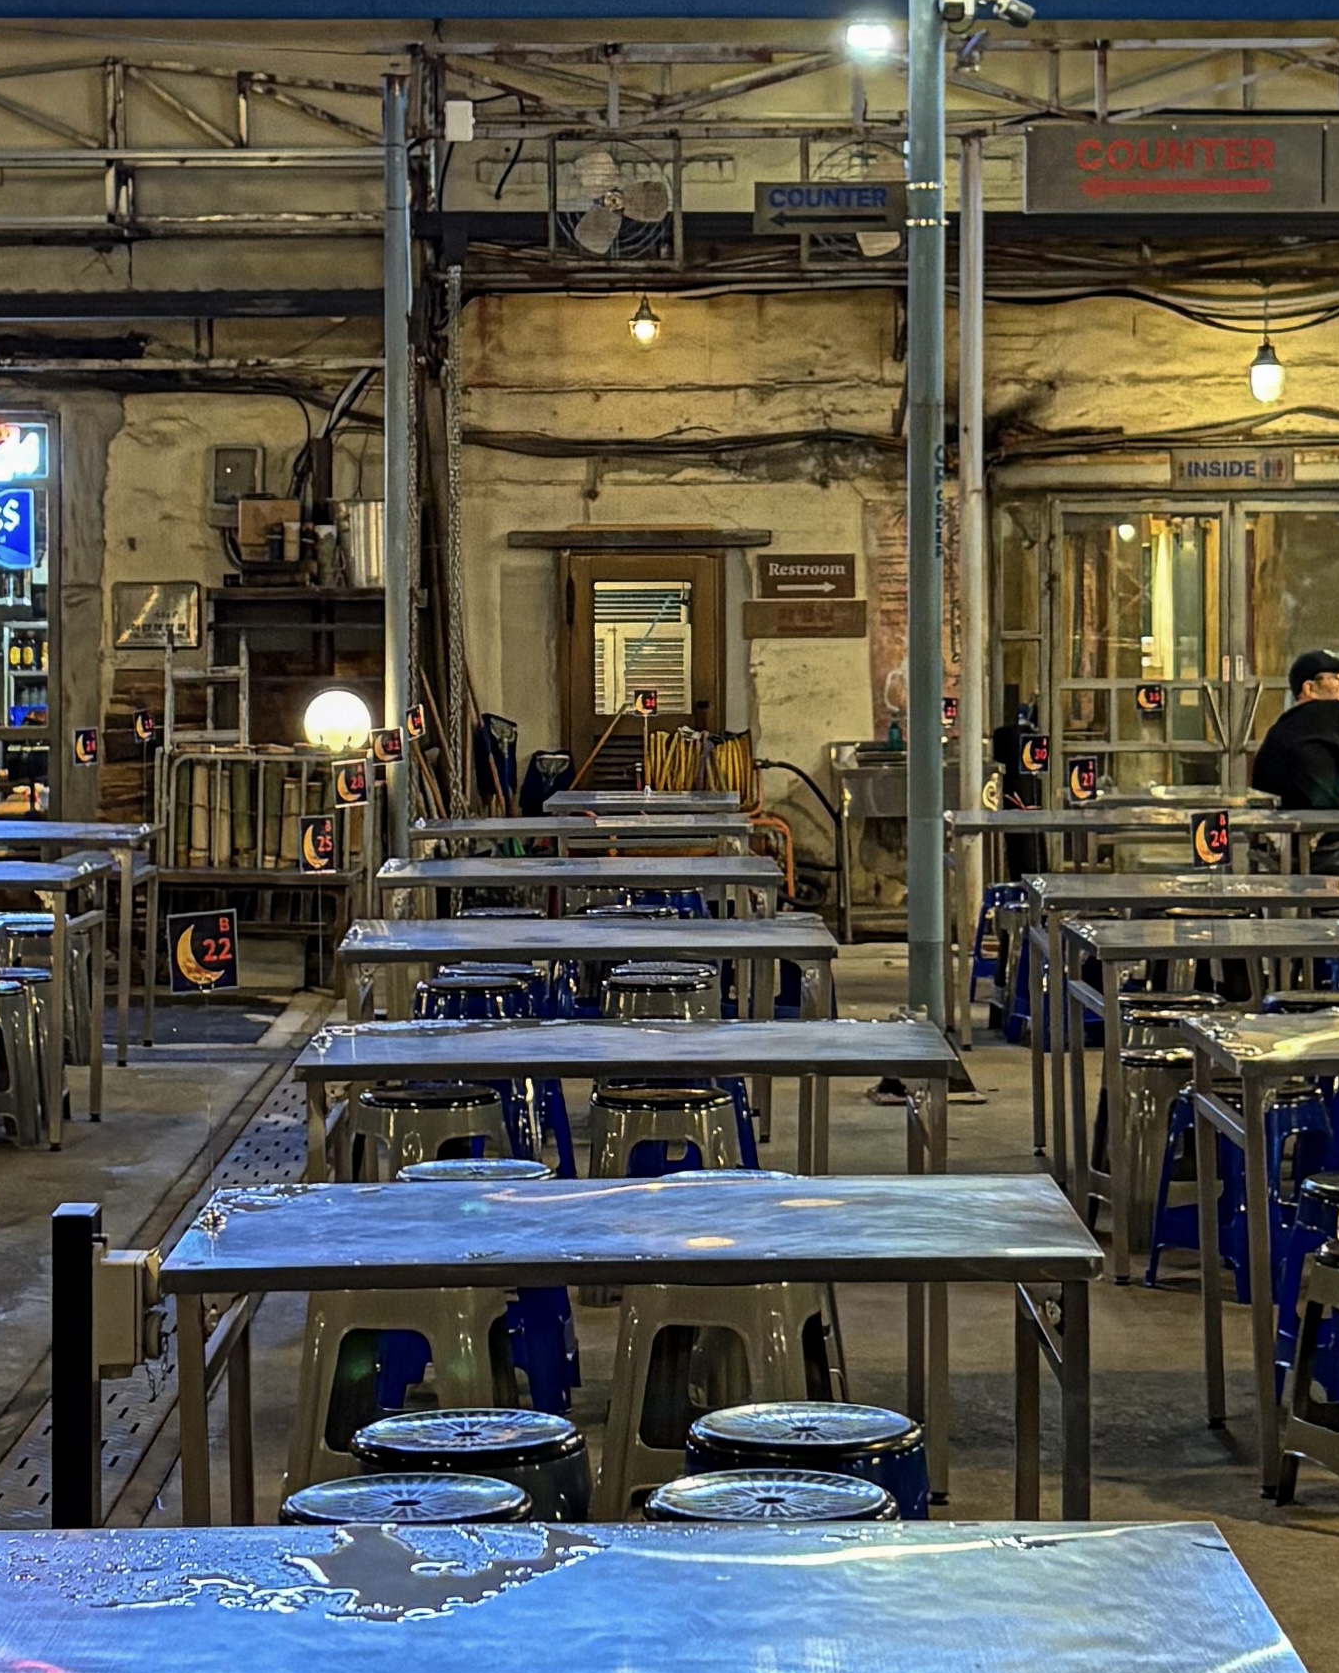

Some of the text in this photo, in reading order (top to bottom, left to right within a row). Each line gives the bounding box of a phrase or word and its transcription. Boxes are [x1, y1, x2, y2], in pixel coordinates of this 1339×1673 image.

[1074, 138, 1276, 172] COUNTER
[768, 187, 887, 208] COUNTER
[1187, 460, 1257, 478] INSIDE
[768, 562, 846, 576] Restroom
[316, 835, 333, 852] 25
[1209, 829, 1227, 847] 24
[219, 917, 230, 933] B
[202, 937, 233, 961] 22
